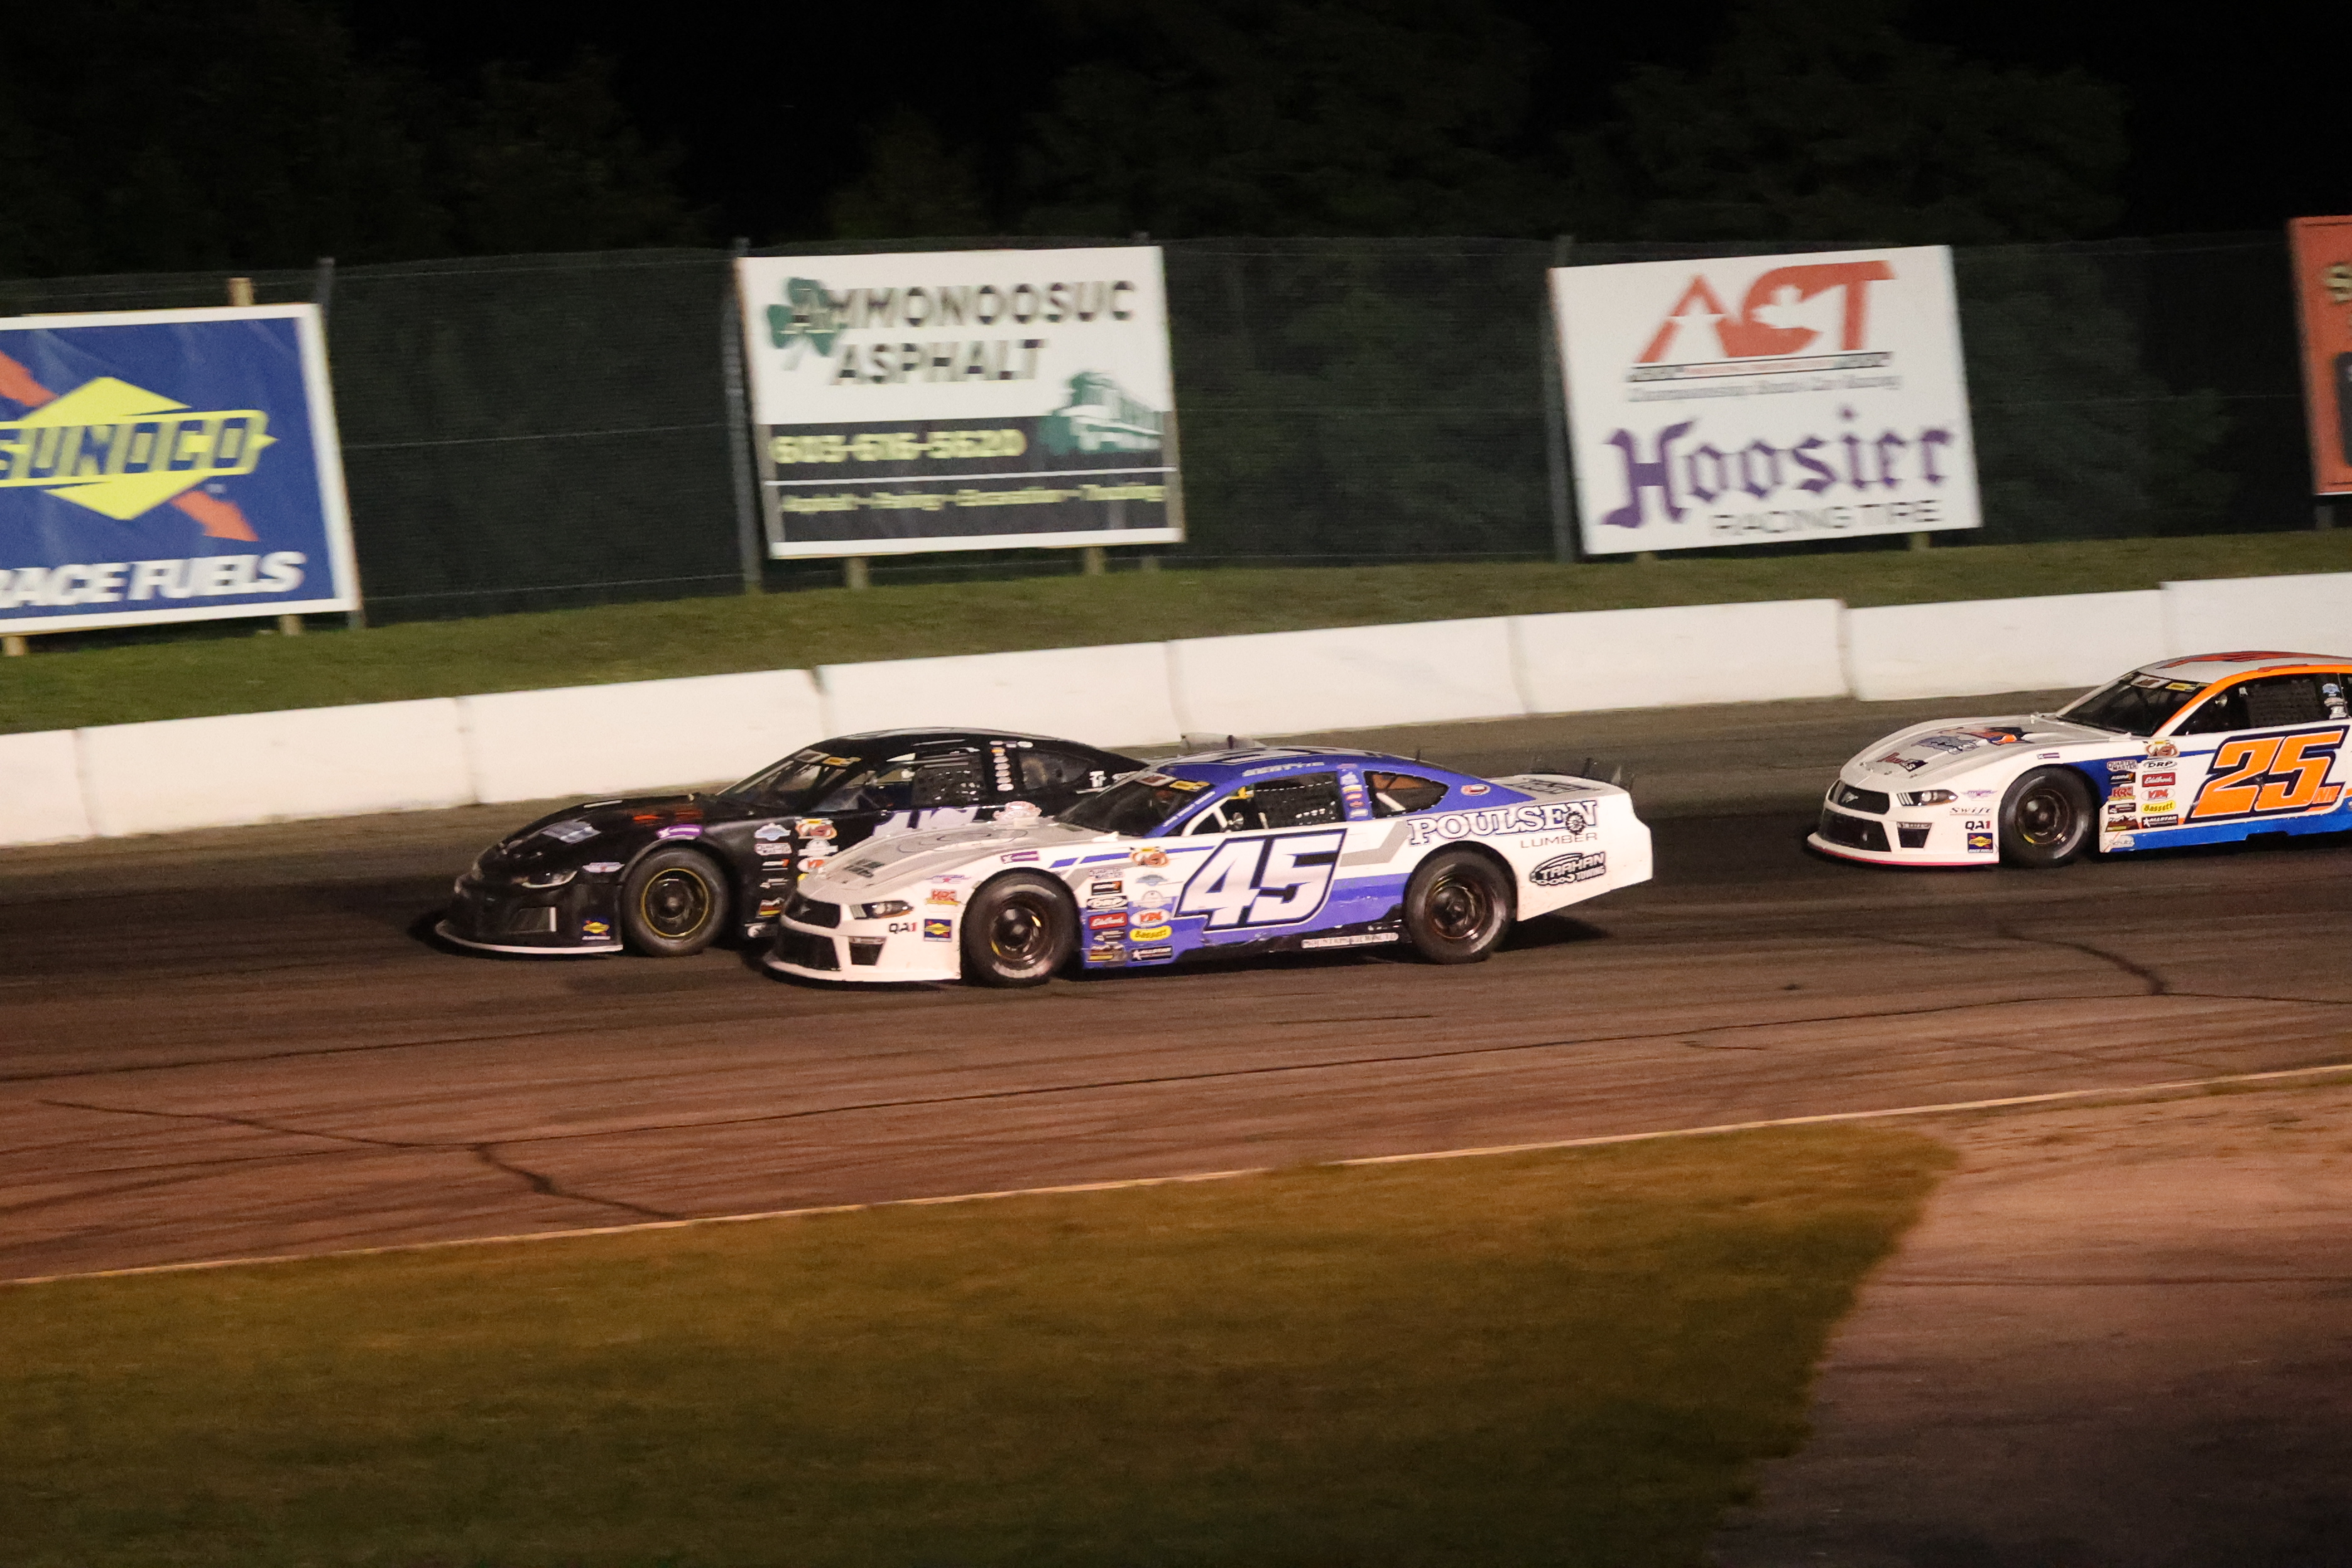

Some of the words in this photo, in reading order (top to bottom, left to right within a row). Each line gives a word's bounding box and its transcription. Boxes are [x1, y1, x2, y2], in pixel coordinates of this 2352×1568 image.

[1634, 259, 1897, 363] ACT
[830, 339, 1047, 384] ASPHALT
[1599, 406, 1953, 528] Hoosier
[128, 551, 307, 600] FUELS
[2189, 729, 2344, 819] 25
[1407, 799, 1598, 846] POULSEN
[1521, 832, 1598, 847] LUMBER
[1965, 820, 1991, 830] QA1
[1177, 832, 1344, 928] 45
[1540, 854, 1605, 879] TRAHAN
[889, 922, 917, 934] QA1
